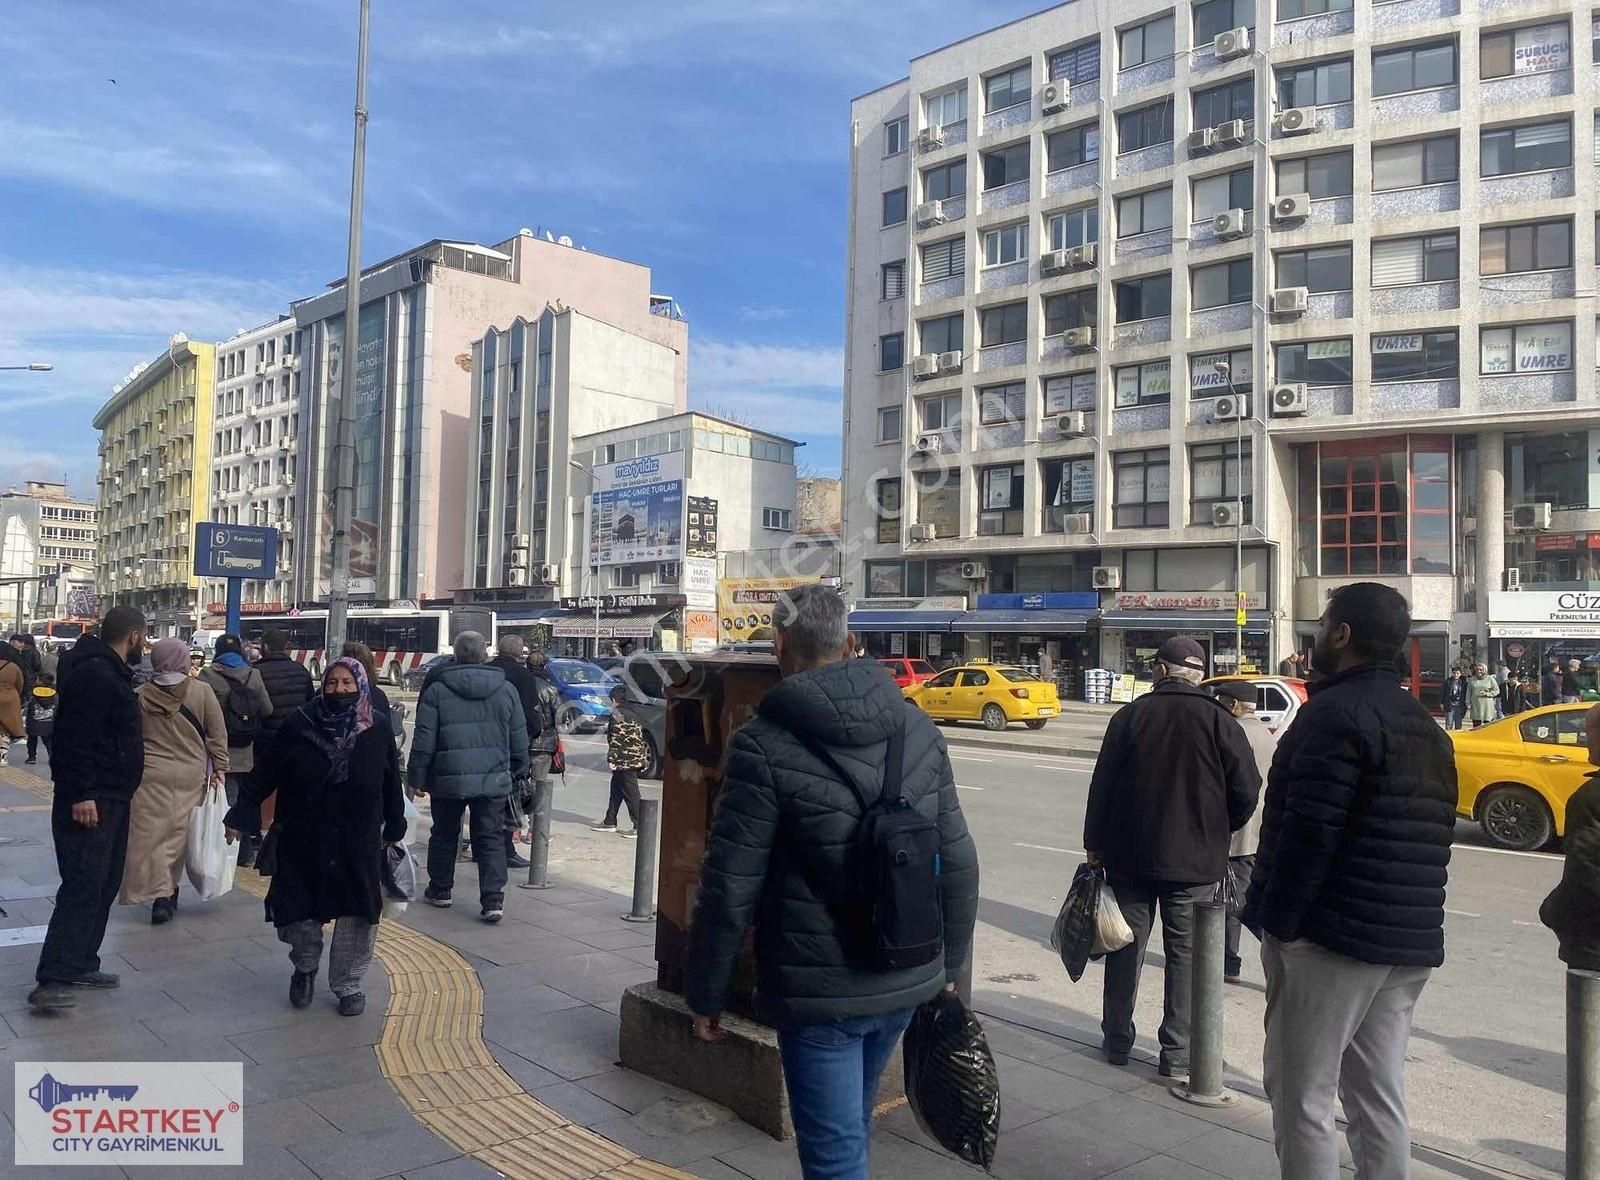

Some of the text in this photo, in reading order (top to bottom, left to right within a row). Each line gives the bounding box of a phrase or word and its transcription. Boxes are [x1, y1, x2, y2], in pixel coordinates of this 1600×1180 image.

[1526, 55, 1558, 66] HAC
[1376, 335, 1419, 350] UMRE
[1520, 353, 1568, 369] UMRE
[215, 531, 225, 544] 6
